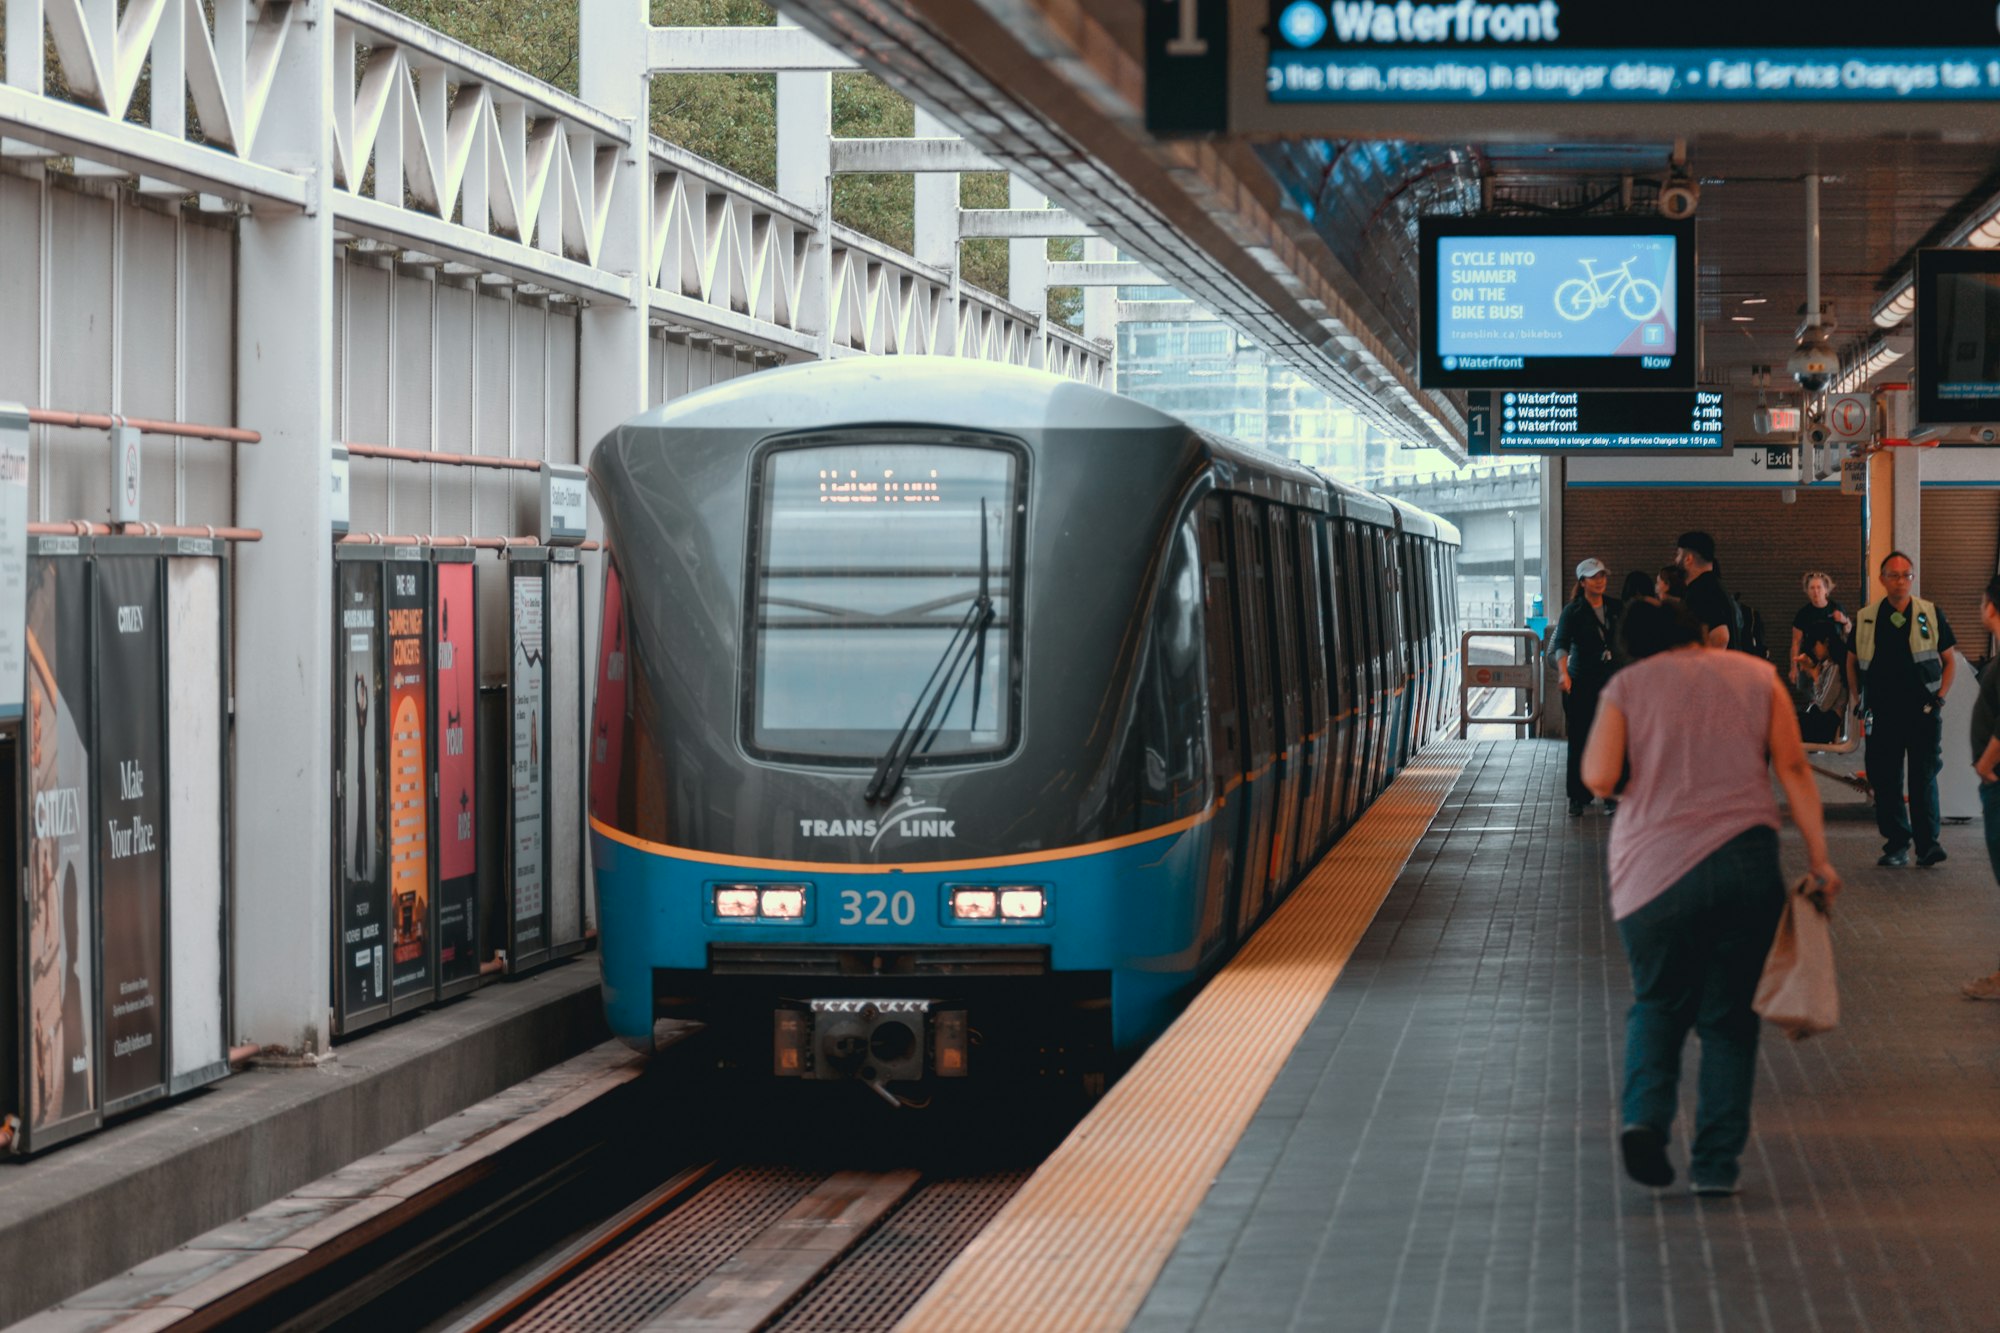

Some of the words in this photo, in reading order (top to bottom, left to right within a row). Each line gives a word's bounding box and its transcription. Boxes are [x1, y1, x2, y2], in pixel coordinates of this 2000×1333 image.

[1331, 0, 1559, 42] Waterfront
[1286, 63, 1324, 91] the
[1327, 63, 1386, 92] train,
[1387, 63, 1487, 96] resulting
[1489, 63, 1512, 90] in
[1514, 66, 1531, 90] a
[1532, 63, 1609, 96] longer
[1708, 60, 1751, 89] Fall
[1754, 60, 1840, 89] Service
[1841, 60, 1939, 95] Changes
[1451, 252, 1496, 266] CYCLE
[1500, 252, 1536, 266] INTO
[1451, 270, 1517, 284] SUMMER
[1451, 288, 1475, 302] ON
[1478, 288, 1506, 302] THE
[1451, 305, 1486, 320] BIKE
[1489, 306, 1524, 320] BUS!
[1451, 329, 1564, 340] translink.ca/bikebus
[1459, 356, 1523, 368] Waterfront
[1643, 356, 1671, 368] Now
[1517, 392, 1578, 404] Waterfront
[1697, 392, 1722, 404] Now
[1517, 406, 1578, 418] Waterfront
[1693, 406, 1700, 418] 4
[1702, 406, 1722, 418] min
[1773, 411, 1794, 428] EXIT
[1472, 414, 1485, 436] 1
[1517, 420, 1578, 432] Waterfront
[1693, 420, 1700, 432] 6
[1702, 420, 1722, 432] min
[1506, 437, 1516, 445] the
[1517, 437, 1533, 446] train,
[1534, 437, 1559, 447] resulting
[1561, 437, 1566, 445] in
[1572, 437, 1592, 447] longer
[1618, 437, 1630, 445] Fall
[1630, 437, 1653, 445] Service
[1653, 437, 1679, 447] Changes
[1767, 452, 1792, 466] Exit
[118, 605, 144, 634] CITIZEN
[438, 640, 453, 670] FIND
[445, 727, 464, 756] YOUR
[120, 759, 144, 800] Make
[35, 787, 81, 839] CITIZEN
[457, 812, 471, 841] RIDE
[800, 819, 878, 837] TRANS
[900, 820, 956, 838] LINK
[108, 819, 132, 859] Your
[132, 815, 156, 856] Place.
[839, 890, 915, 926] 320
